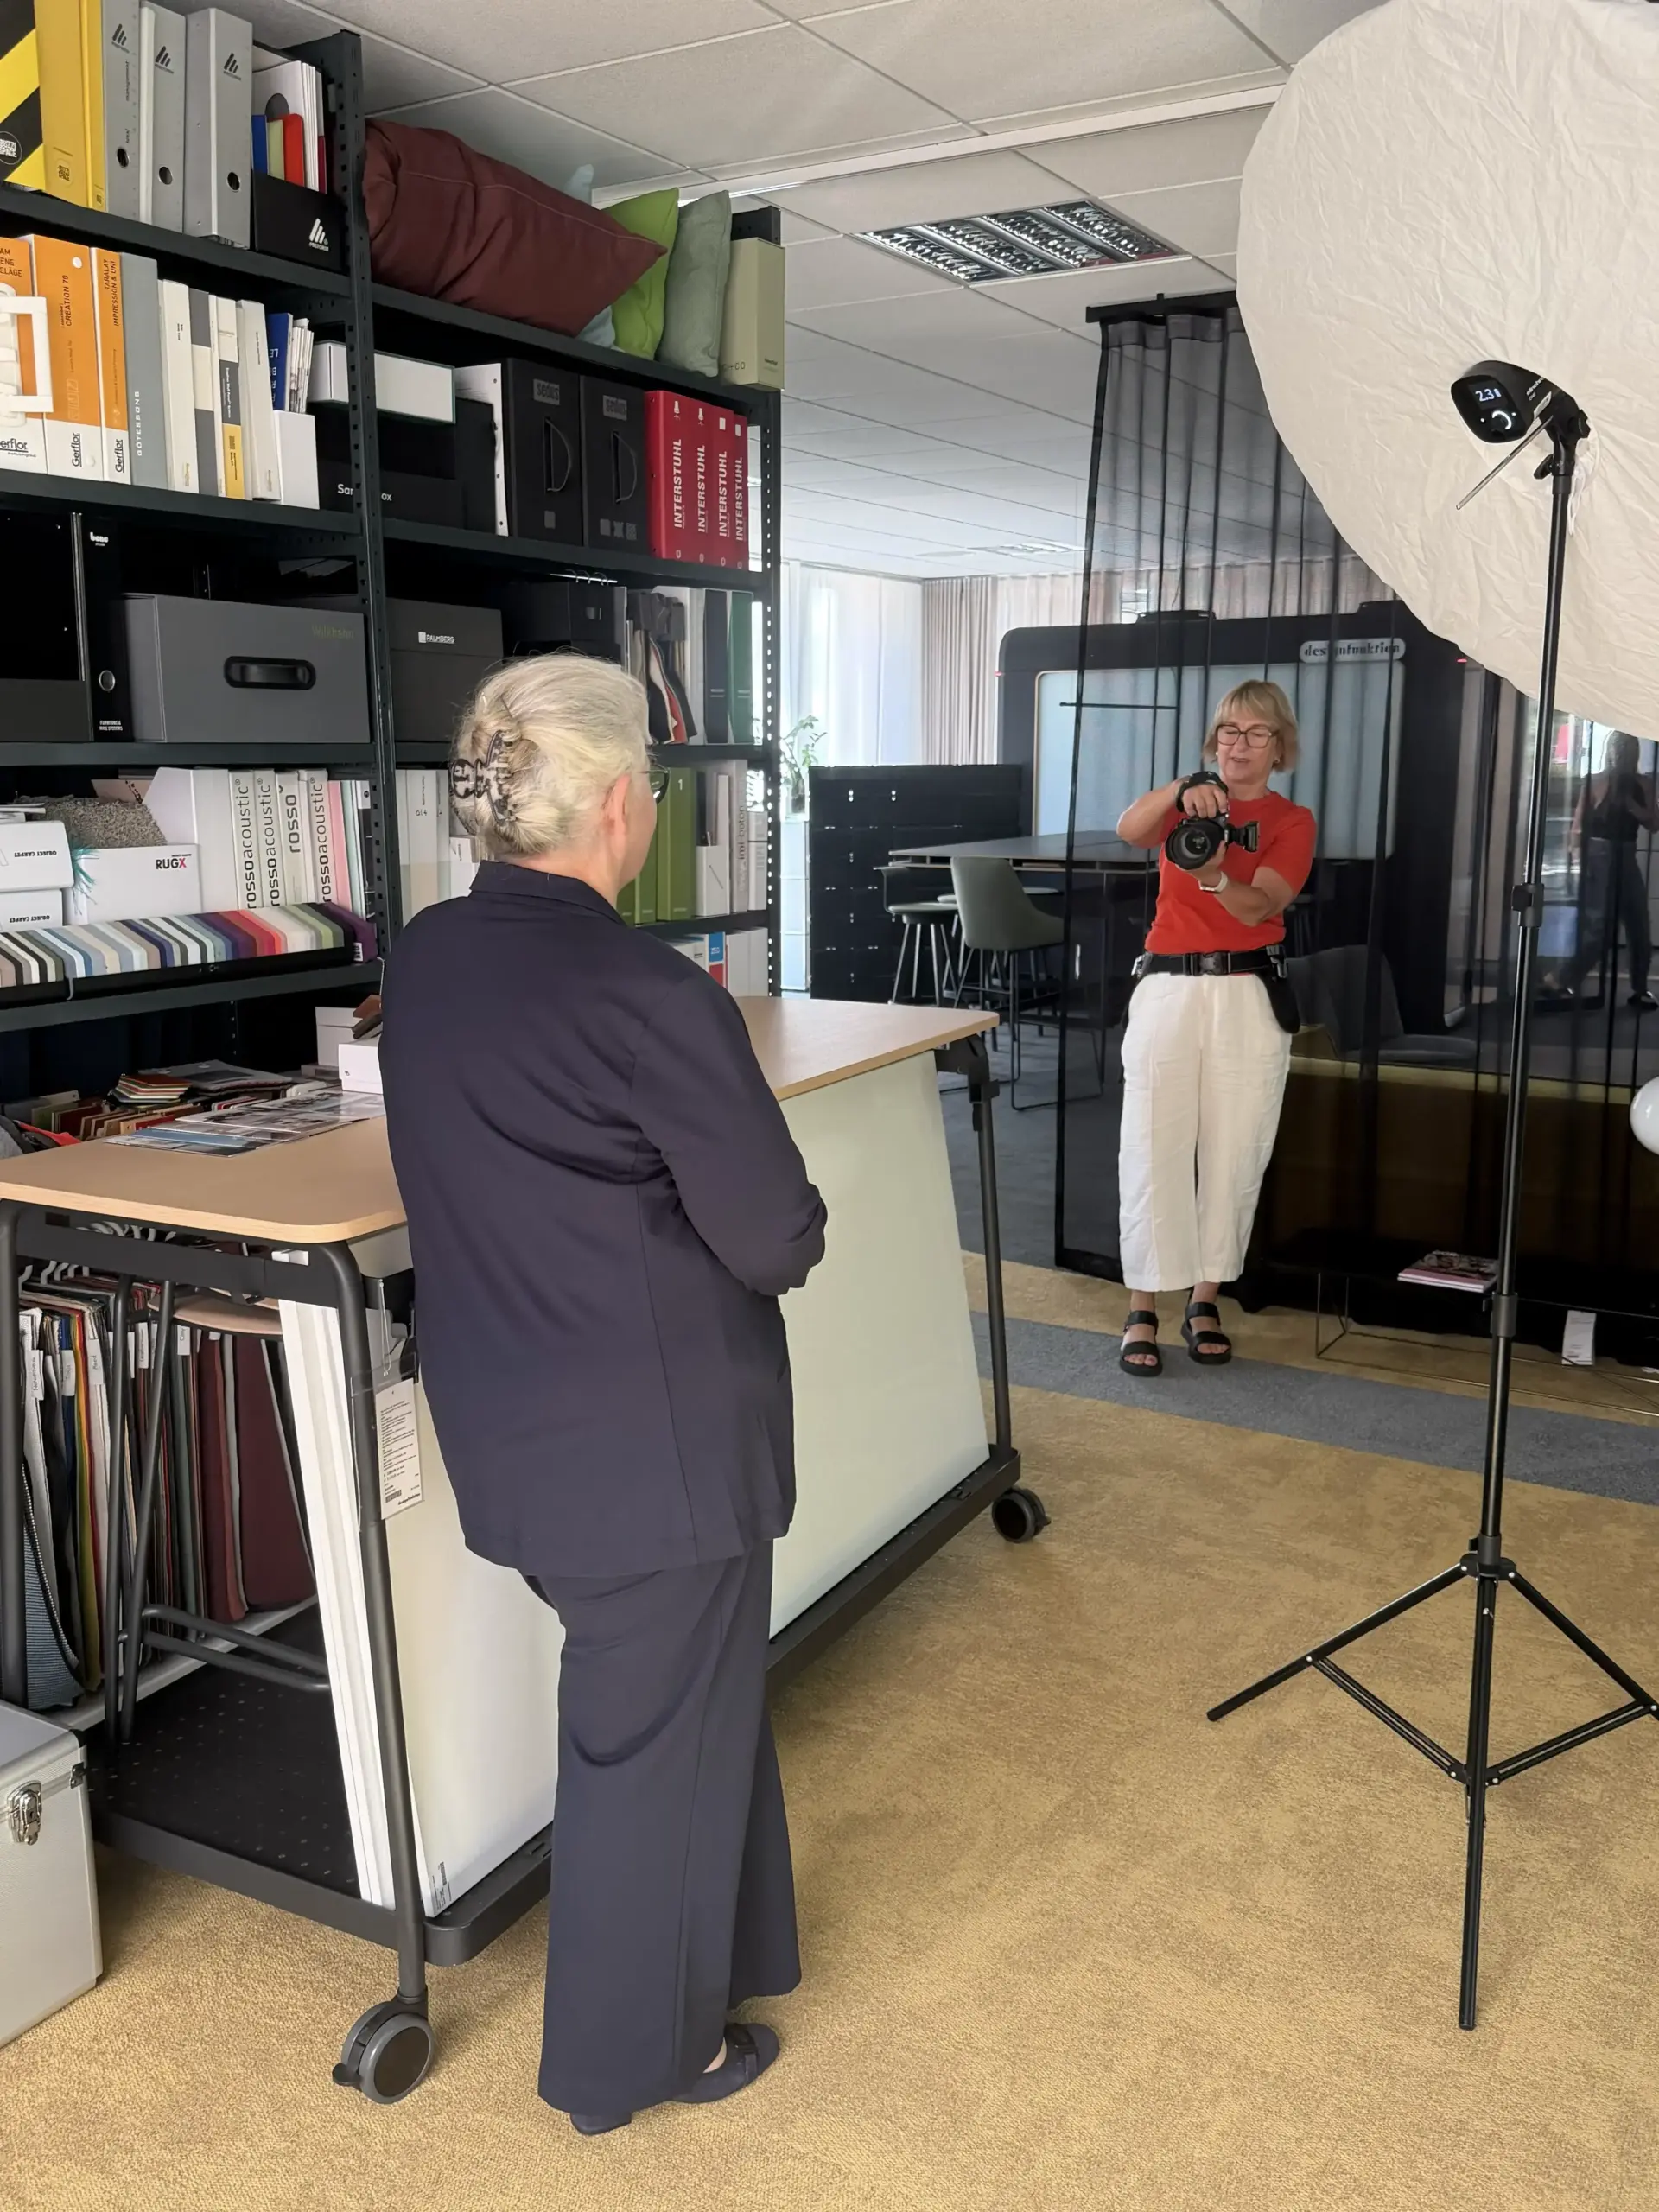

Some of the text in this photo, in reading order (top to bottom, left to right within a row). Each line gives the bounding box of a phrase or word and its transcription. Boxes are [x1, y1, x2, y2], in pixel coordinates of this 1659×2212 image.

[61, 274, 73, 327] CREATION 70
[111, 283, 121, 327] IMPRESSION
[0, 438, 29, 453] erflor
[71, 432, 82, 467] Gerflor
[115, 439, 124, 473] Gerflor
[673, 439, 683, 528] INTERSTUHL
[697, 445, 706, 533] INTERSTUHL
[719, 451, 728, 537] INTERSTUHL
[426, 633, 455, 645] PALMBERG
[1305, 641, 1401, 657] desnfunktion
[677, 779, 683, 791] 1
[285, 794, 301, 854] rosso
[156, 857, 187, 870] RUGX
